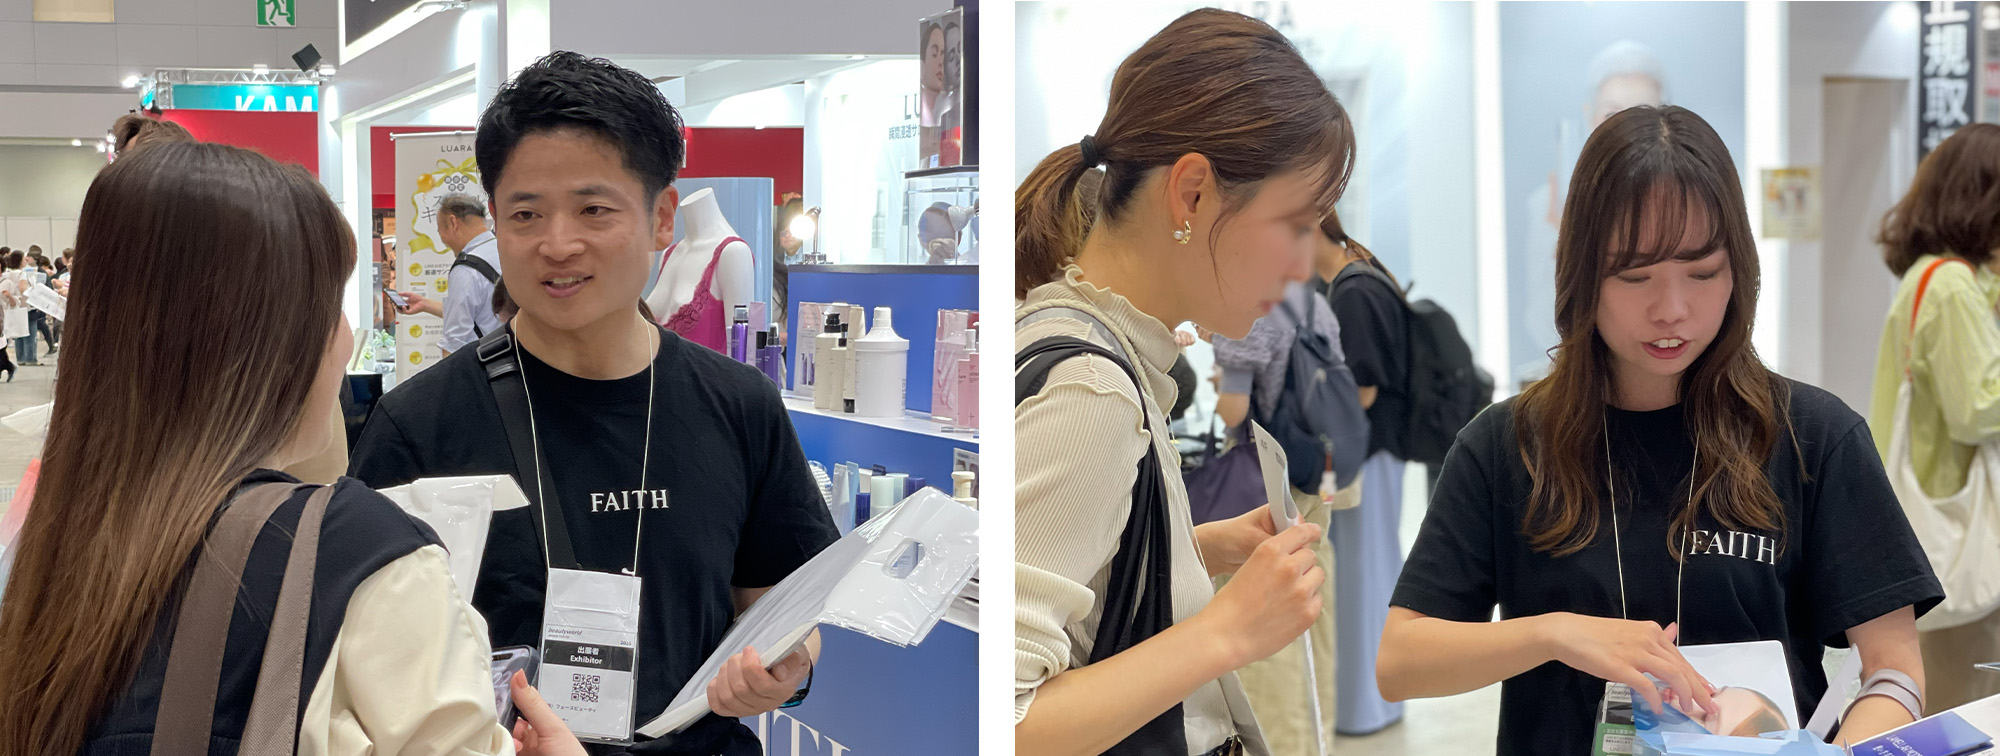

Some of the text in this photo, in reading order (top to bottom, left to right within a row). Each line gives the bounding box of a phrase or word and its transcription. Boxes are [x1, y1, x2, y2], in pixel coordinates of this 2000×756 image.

[590, 489, 669, 513] FAITH
[1689, 530, 1775, 565] FAITH
[570, 655, 602, 665] Exhibitor
